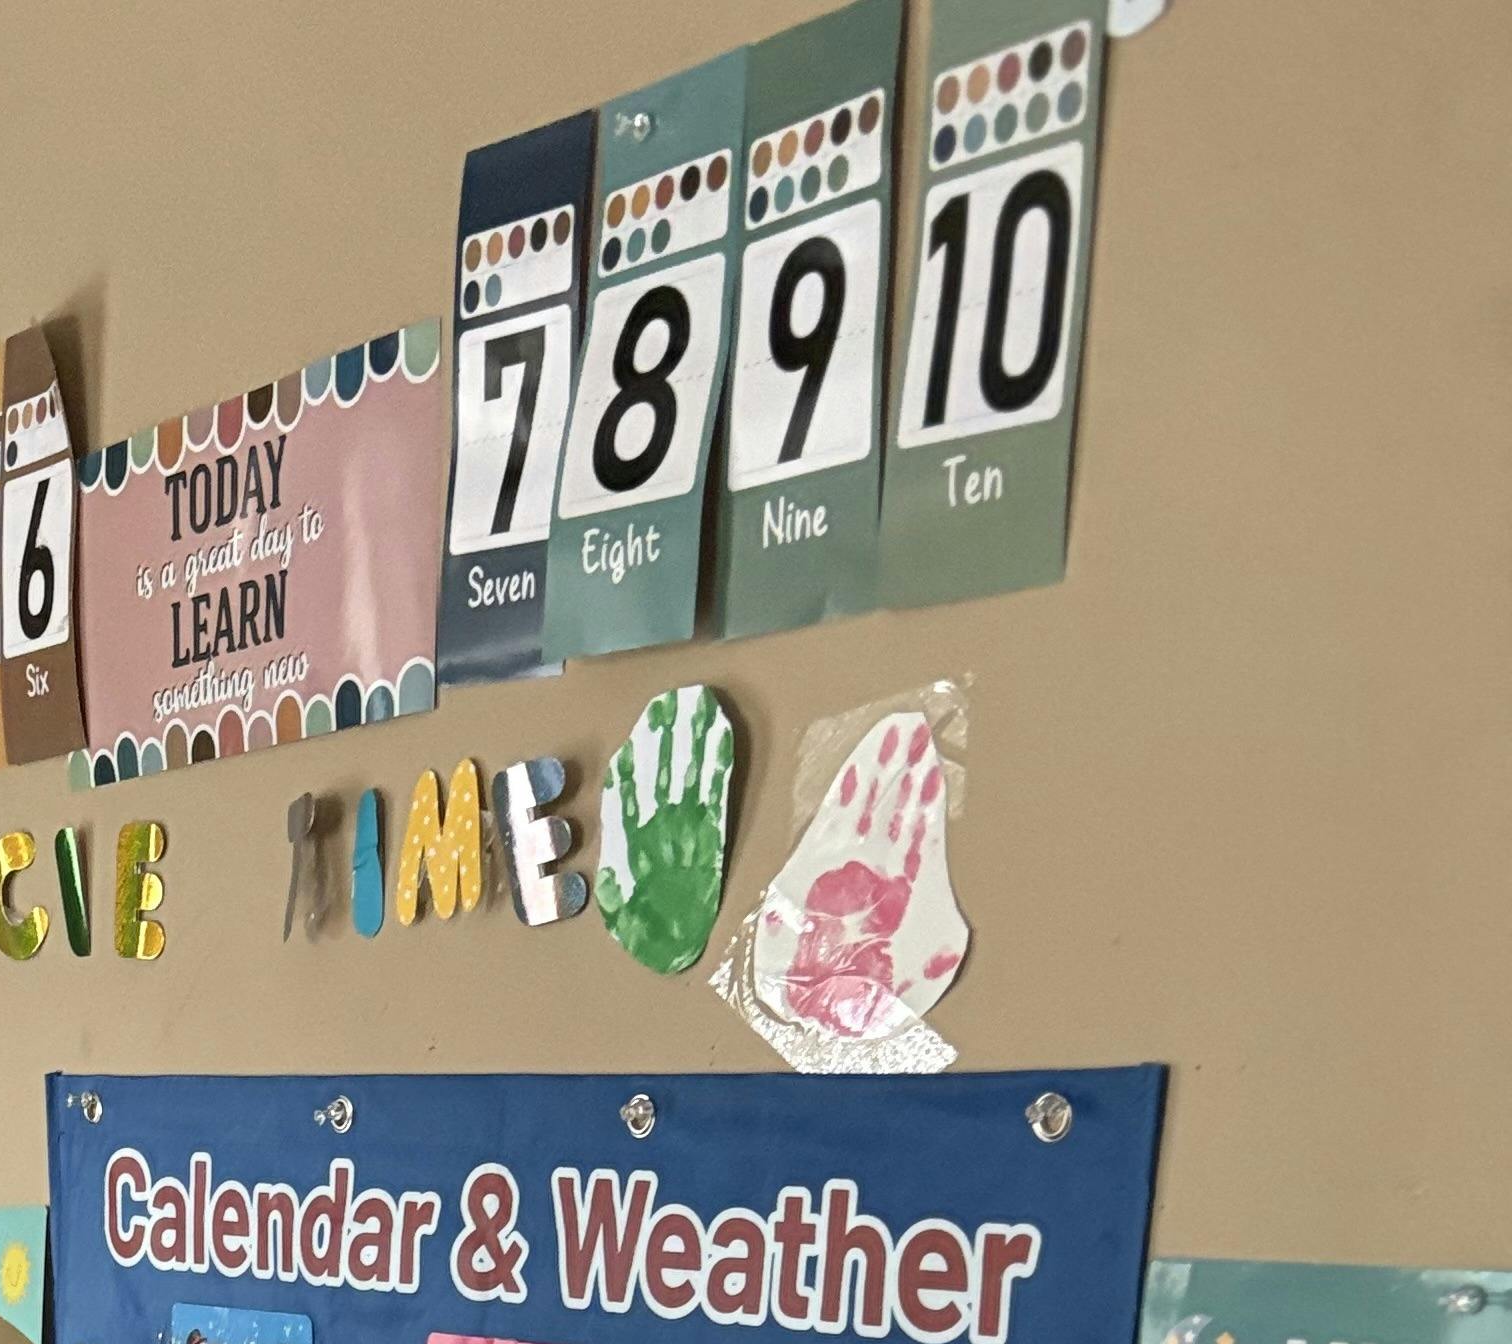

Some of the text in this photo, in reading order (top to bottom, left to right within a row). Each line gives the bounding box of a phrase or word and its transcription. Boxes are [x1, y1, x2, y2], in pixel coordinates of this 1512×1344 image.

[924, 168, 1072, 429] 10
[592, 284, 690, 492] 8
[768, 236, 846, 464] 9
[484, 324, 546, 536] 7
[164, 434, 287, 541] TODAY
[762, 496, 829, 549] Nine
[942, 455, 1004, 508] Ten
[18, 478, 55, 639] 6
[135, 504, 325, 600] is a great day to
[467, 565, 536, 608] Seven
[580, 524, 661, 582] Eight
[171, 569, 287, 669] LEARN
[26, 664, 49, 697] Six
[152, 650, 309, 724] something new
[104, 1147, 440, 1293] Calendar
[451, 1163, 529, 1303] &
